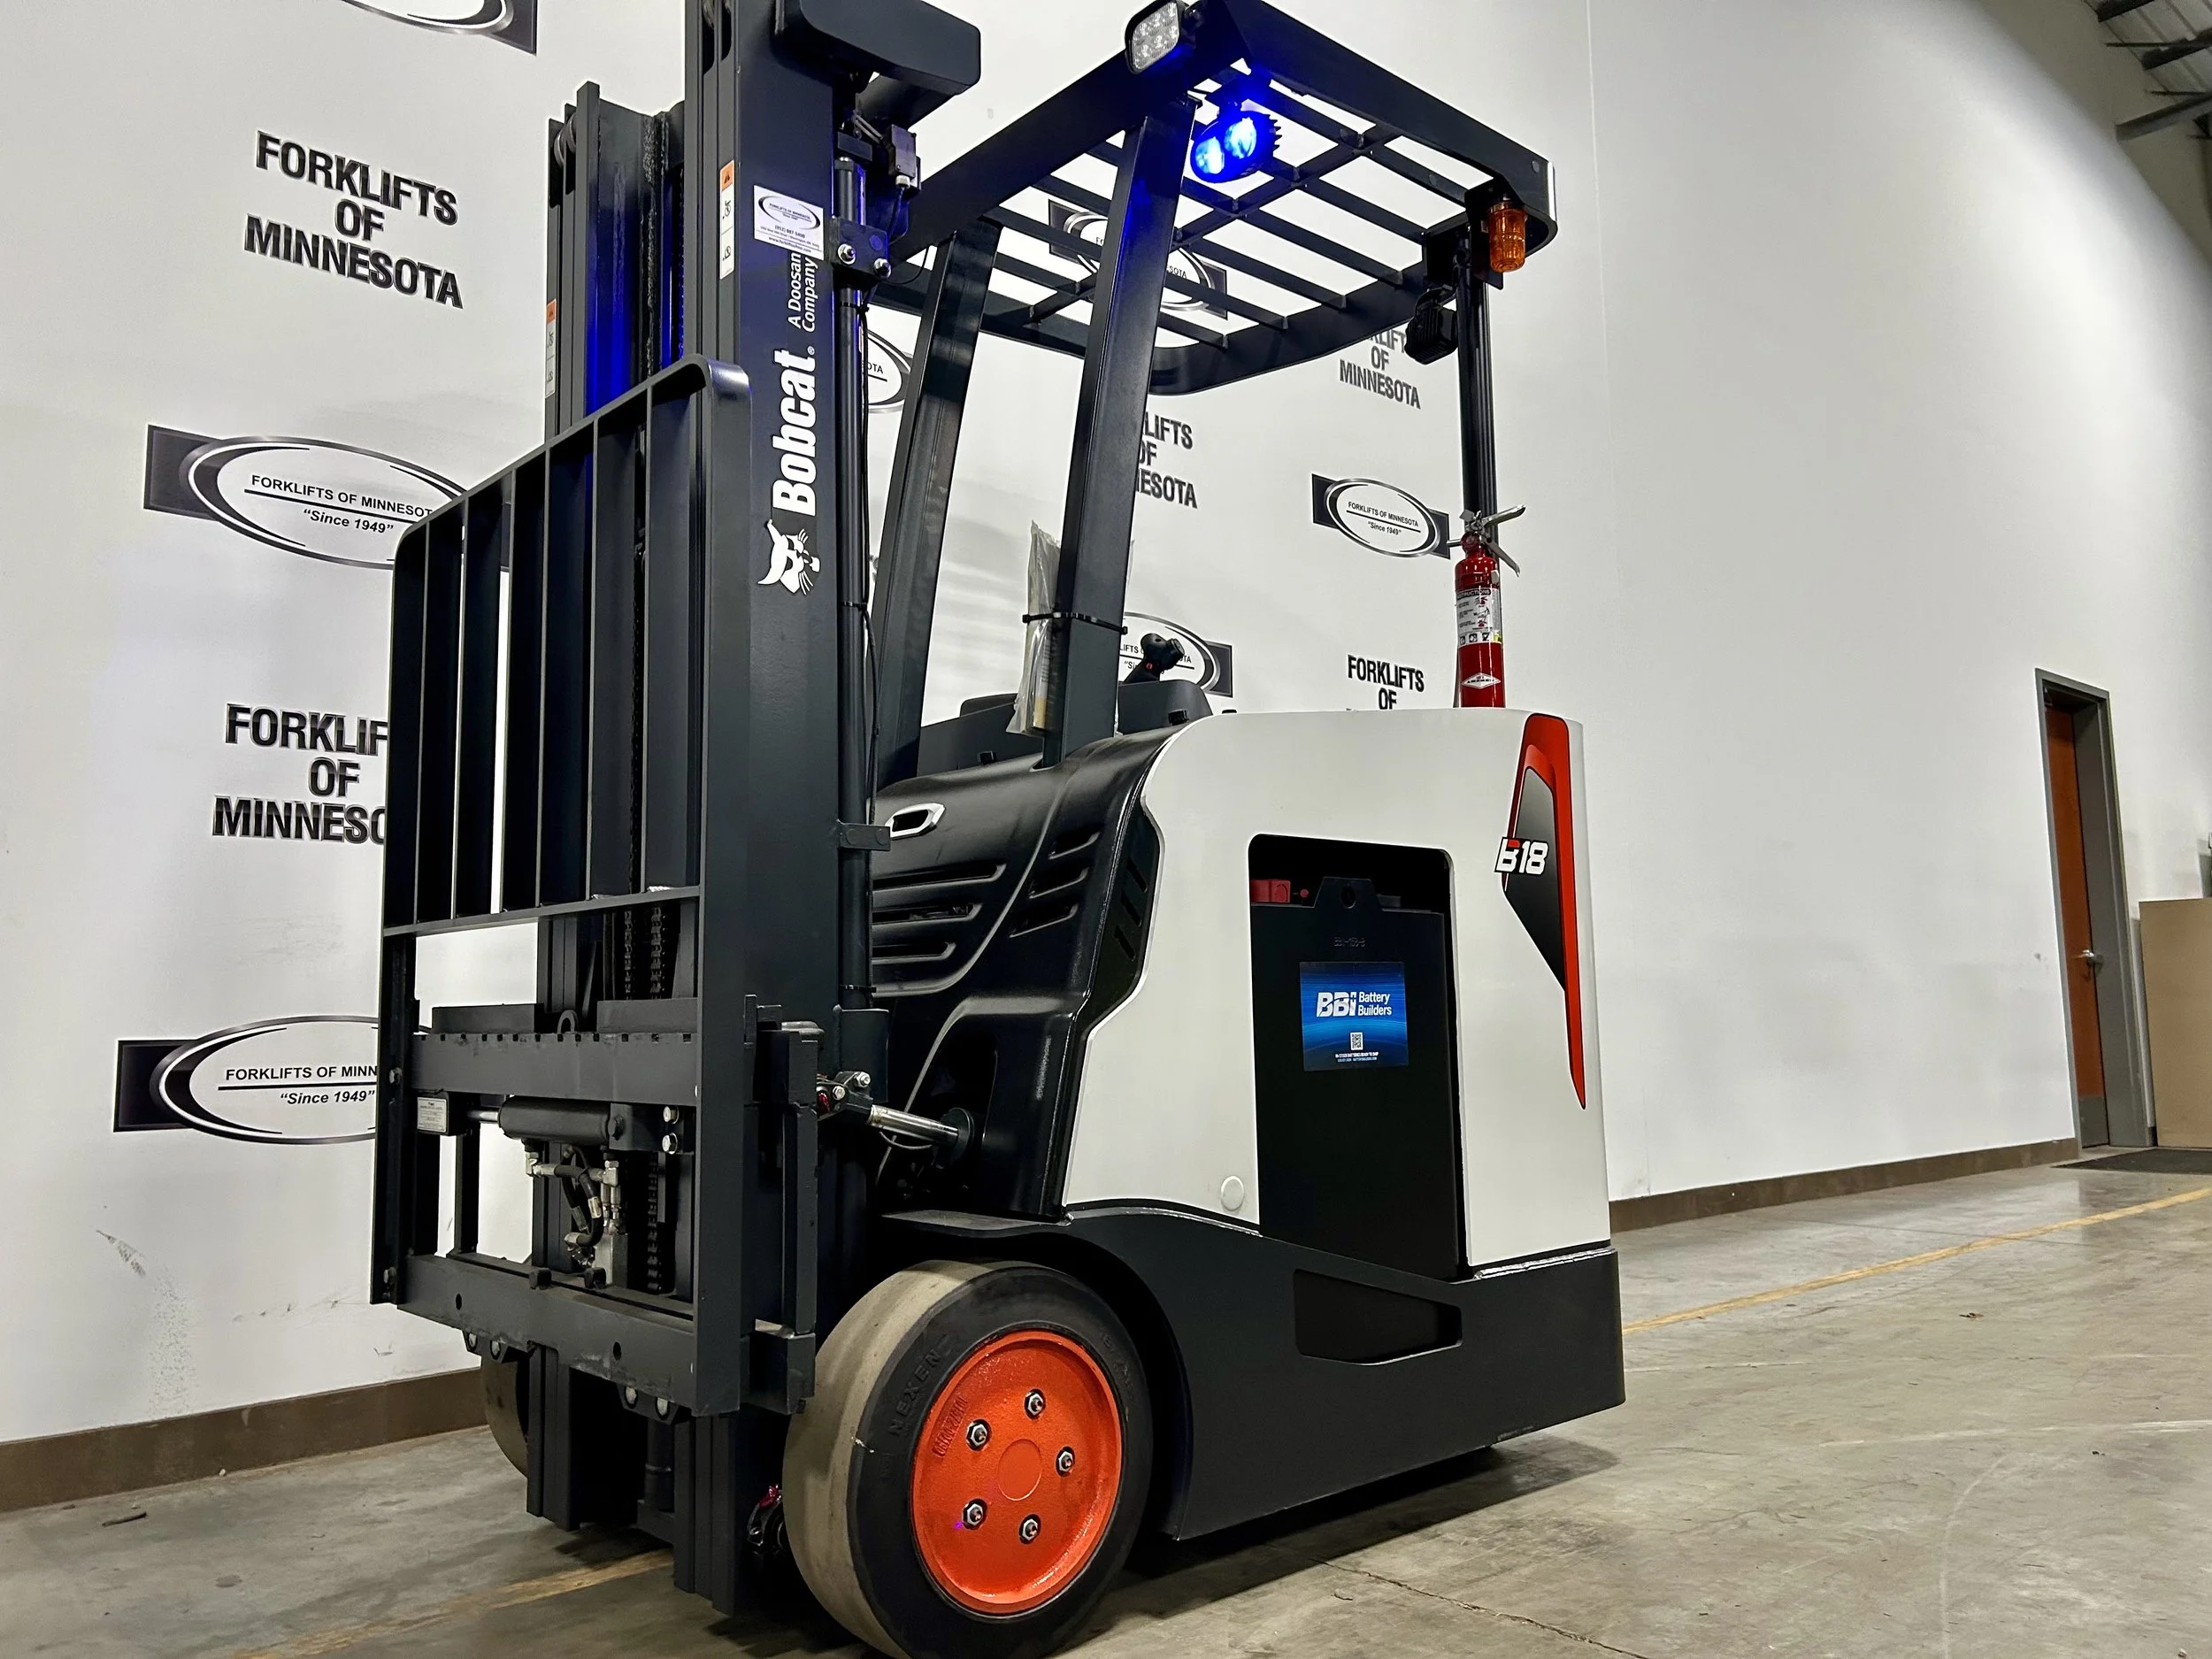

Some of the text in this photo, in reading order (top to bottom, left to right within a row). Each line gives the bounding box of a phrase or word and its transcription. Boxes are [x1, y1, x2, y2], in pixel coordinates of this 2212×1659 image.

[256, 130, 458, 227] FORKLIFTS
[334, 198, 385, 241] OF
[244, 213, 463, 309] MINNESOTA
[787, 252, 802, 329] A Doosan
[802, 257, 818, 333] Company
[1371, 345, 1389, 371] OF
[1340, 358, 1421, 410] MINNESOTA
[1144, 411, 1193, 449] LIFTS
[251, 474, 433, 518] FORKLIFTS OF MINNESOT
[1136, 468, 1198, 509] ESOTA
[303, 509, 394, 534] “Since 1949”
[1348, 501, 1379, 516] FORKLIFTS
[1387, 513, 1418, 527] MINNESOTA
[1348, 654, 1425, 693] FORKLIFTS
[1379, 687, 1397, 710] OF
[226, 703, 388, 757] FORKLIF
[308, 757, 361, 798] OF
[212, 795, 386, 845] MINNESO
[1494, 837, 1549, 876] B18
[1357, 1005, 1393, 1016] Builders
[1358, 991, 1390, 1005] Battery
[226, 1066, 312, 1081] FORKLIFTS
[317, 1066, 337, 1078] OF
[280, 1090, 375, 1105] “Since 1949”
[887, 1349, 942, 1436] NEXEN
